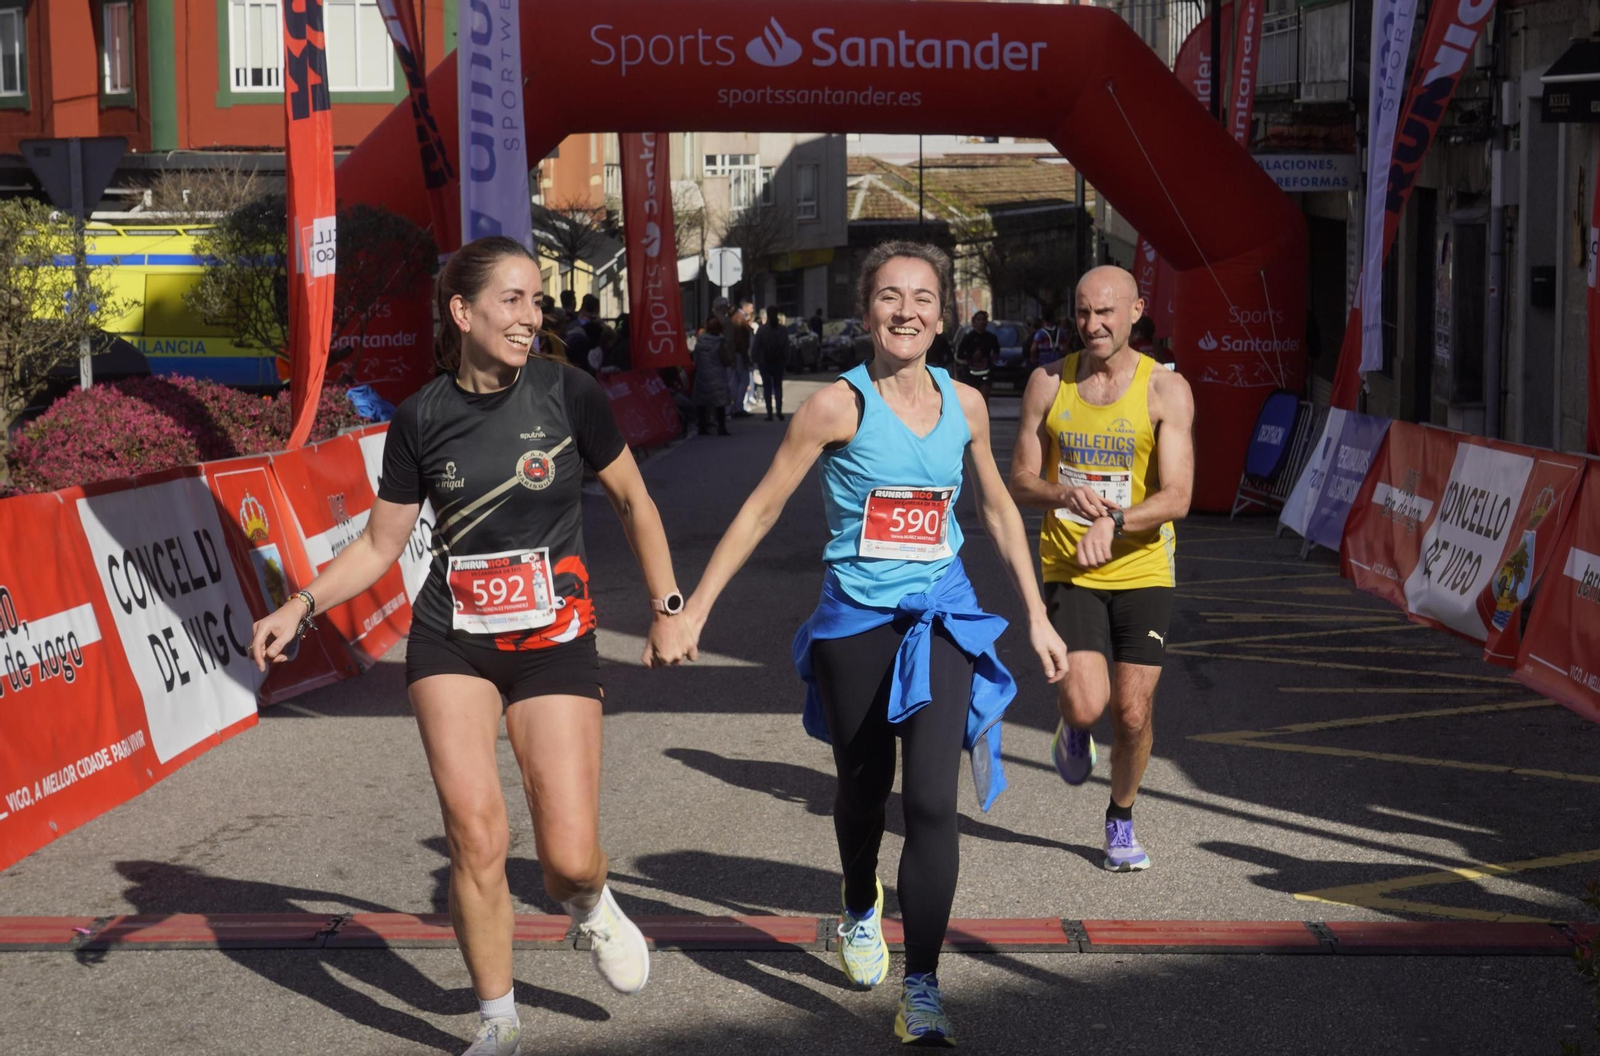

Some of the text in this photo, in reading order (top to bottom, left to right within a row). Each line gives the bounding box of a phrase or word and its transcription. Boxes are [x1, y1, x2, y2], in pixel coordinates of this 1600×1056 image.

[590, 23, 1048, 77] Sports Santander
[717, 85, 922, 108] sportssantander.es
[1276, 177, 1349, 188] REFORMAS
[647, 263, 677, 355] Sports
[1228, 305, 1283, 327] Sports
[1220, 334, 1300, 353] Santander
[1058, 431, 1136, 451] ATHLETICS
[888, 507, 940, 535] 590
[1437, 544, 1482, 596] VIGO
[472, 575, 528, 606] 592
[5, 630, 84, 691] de xogo
[147, 626, 191, 694] DE
[34, 781, 43, 802] A
[42, 764, 79, 797] MELLOR
[76, 747, 113, 779] CIDADE
